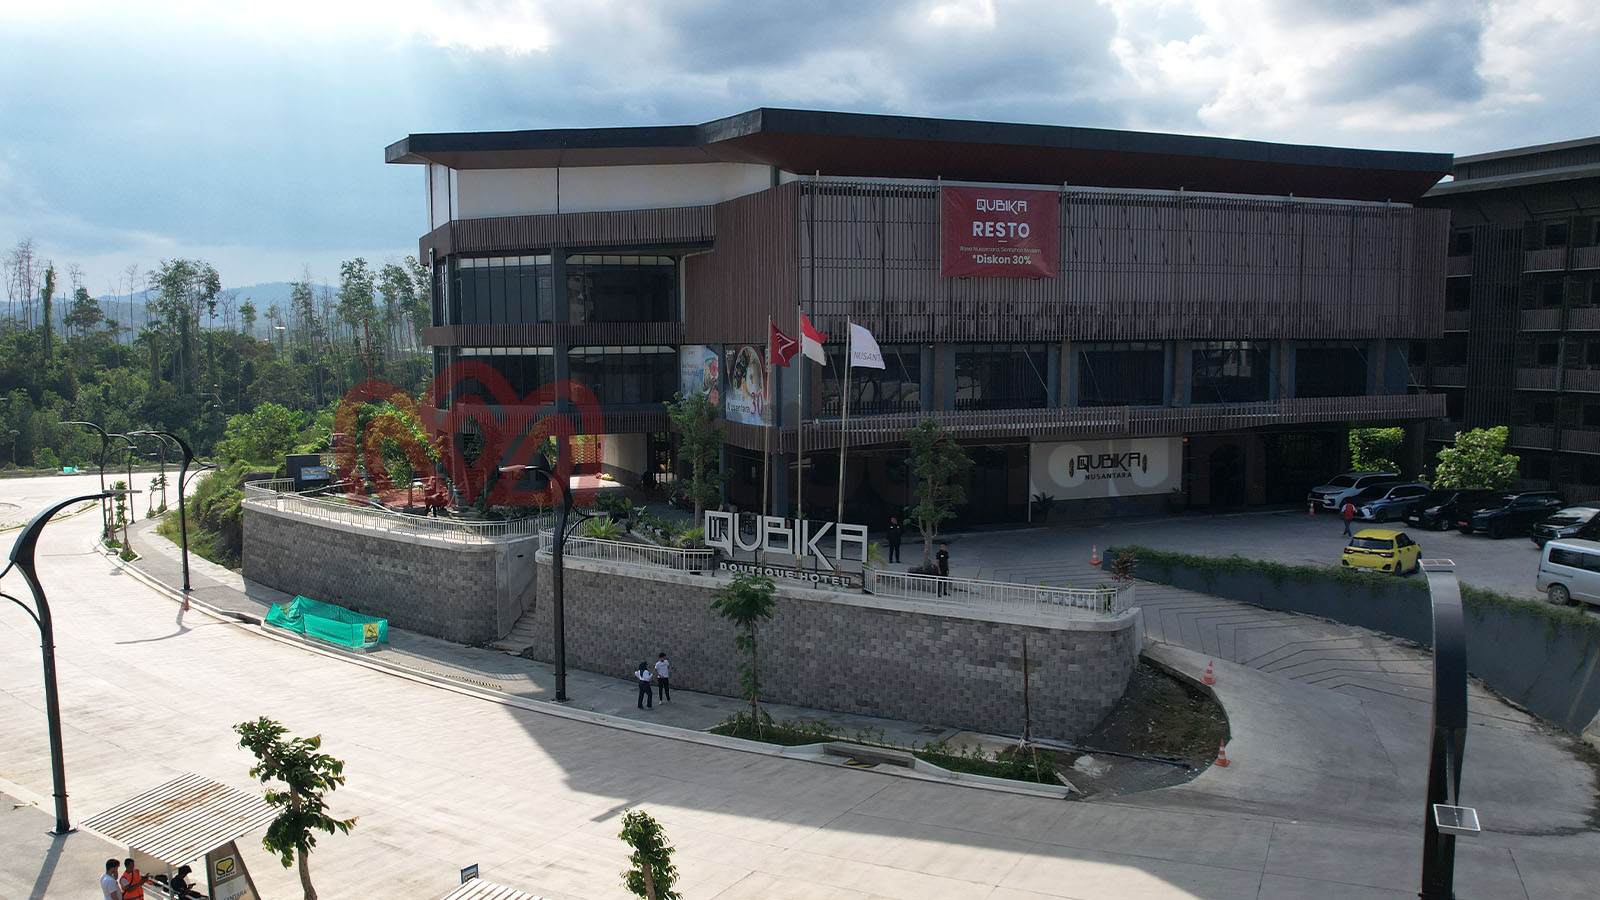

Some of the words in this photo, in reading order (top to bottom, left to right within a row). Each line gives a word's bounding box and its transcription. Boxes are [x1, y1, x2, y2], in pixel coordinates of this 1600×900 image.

[976, 198, 1027, 215] QUBIKA
[972, 221, 1030, 238] RESTO
[1012, 255, 1032, 265] 30%
[1077, 453, 1140, 473] QUBIKA
[705, 510, 868, 571] QUBIKA
[719, 562, 799, 579] BOUTIQUE
[801, 572, 850, 587] HOTEL
